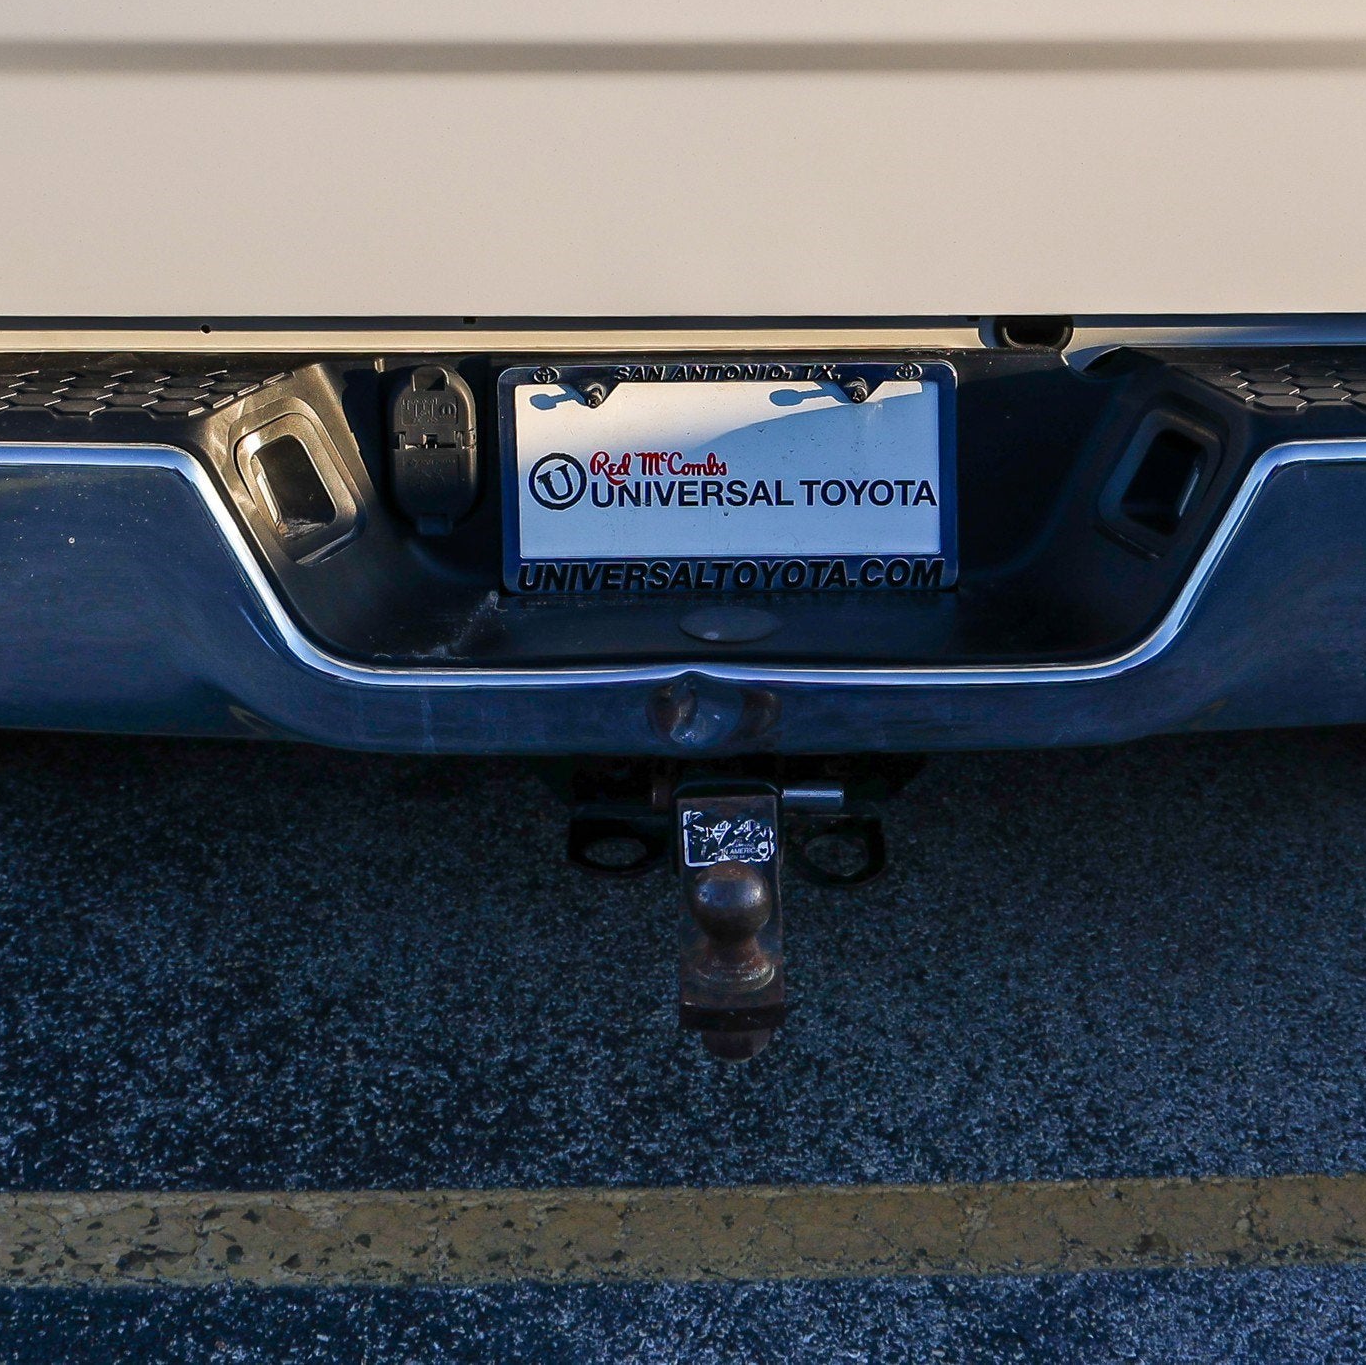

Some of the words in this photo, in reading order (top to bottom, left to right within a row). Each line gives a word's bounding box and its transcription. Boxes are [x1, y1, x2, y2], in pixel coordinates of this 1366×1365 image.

[614, 365, 667, 382] SAN
[589, 450, 632, 486] Red
[634, 450, 727, 476] McCombs
[590, 479, 795, 508] UNIVERSAL
[799, 478, 938, 507] TOYOTA
[516, 558, 945, 592] UNIVERSALTOYOTA.COM
